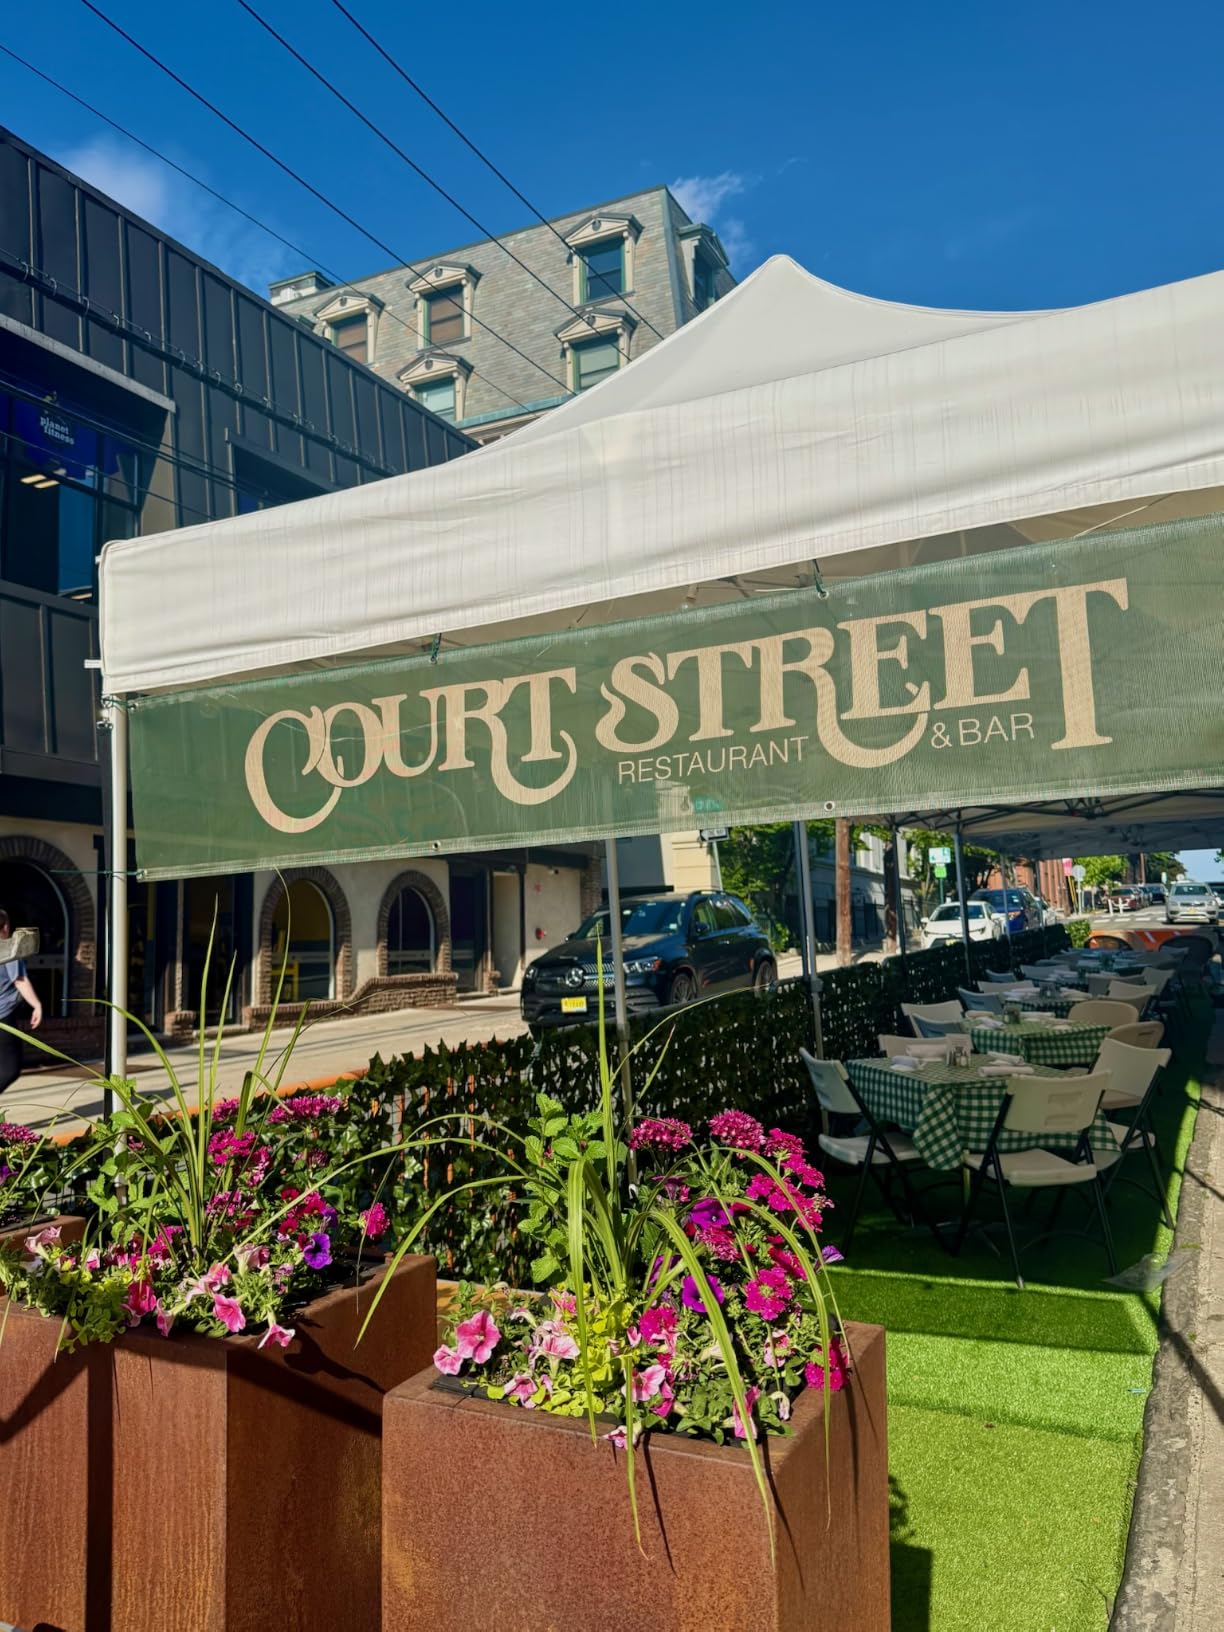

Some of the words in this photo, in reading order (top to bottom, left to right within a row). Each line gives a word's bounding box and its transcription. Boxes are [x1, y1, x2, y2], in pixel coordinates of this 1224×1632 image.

[40, 416, 69, 435] planet
[44, 425, 75, 445] fitness
[245, 666, 577, 833] COURT
[595, 577, 1129, 768] STREET
[617, 736, 809, 785] RESTAURANT
[931, 721, 953, 749] &
[958, 712, 1035, 746] BAR
